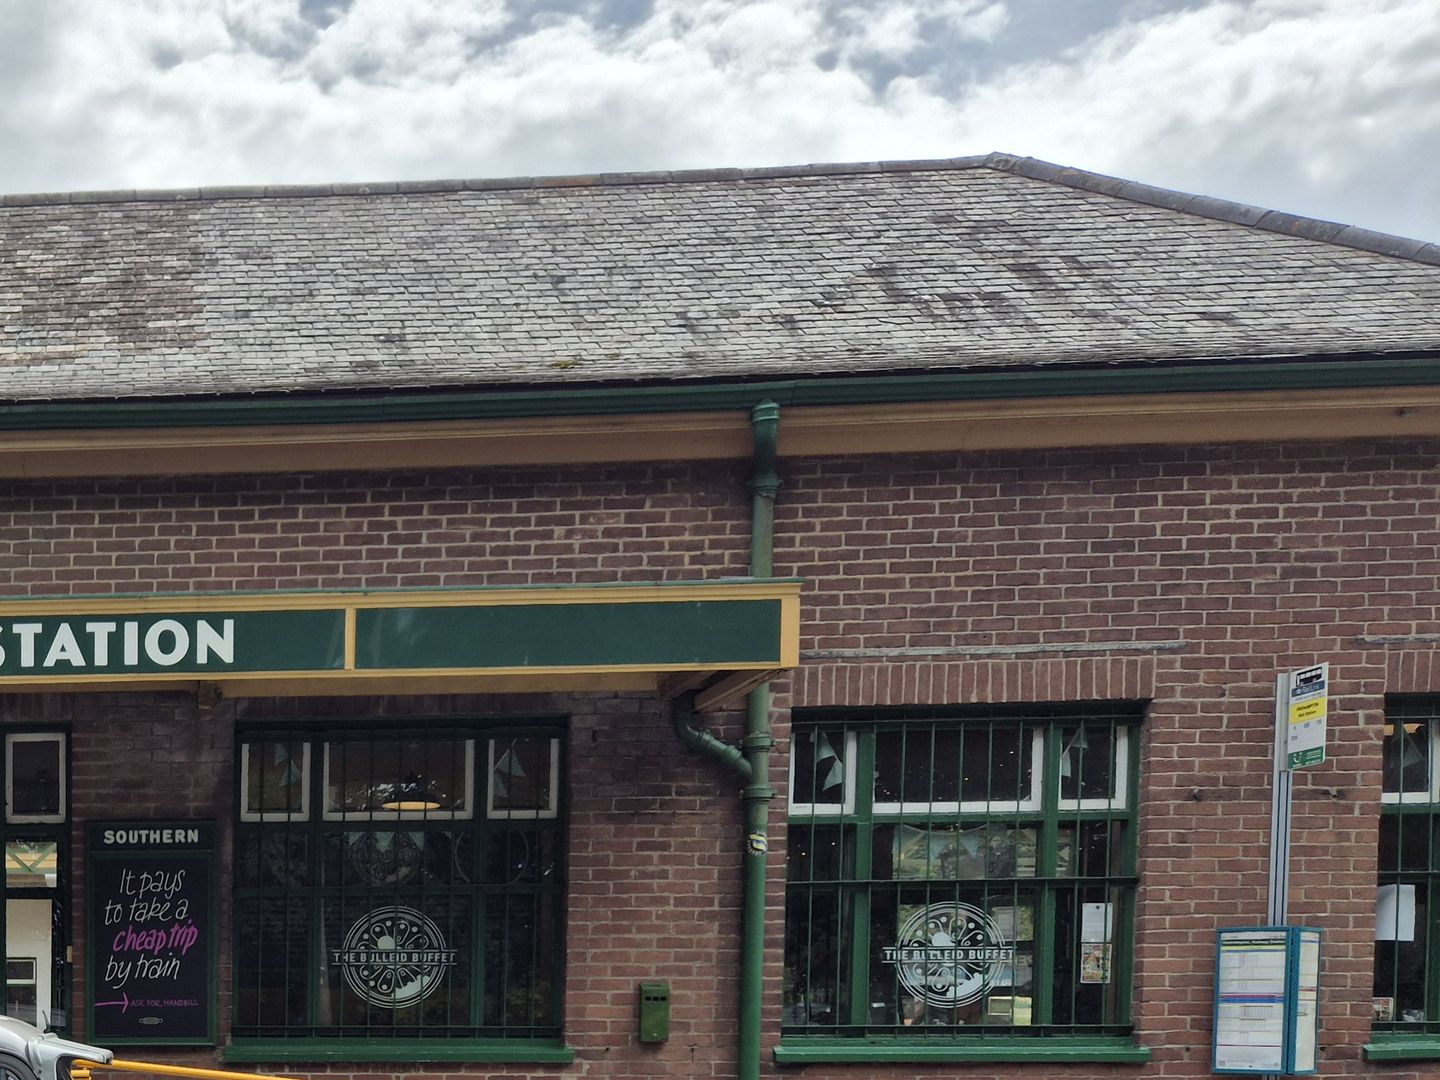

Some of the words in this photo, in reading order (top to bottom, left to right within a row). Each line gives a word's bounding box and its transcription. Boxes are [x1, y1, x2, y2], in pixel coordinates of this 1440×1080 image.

[103, 829, 199, 844] SOUTHERN
[119, 868, 136, 895] It
[140, 870, 186, 899] pays
[105, 899, 123, 925] to
[129, 897, 171, 924] take
[175, 899, 189, 919] a
[113, 925, 167, 955] cheap
[167, 919, 199, 955] trip
[334, 953, 356, 962] THE
[412, 953, 455, 962] BUFFET
[885, 950, 908, 960] THE
[969, 950, 1013, 960] BUFFET
[105, 955, 132, 989] by
[135, 952, 181, 981] train
